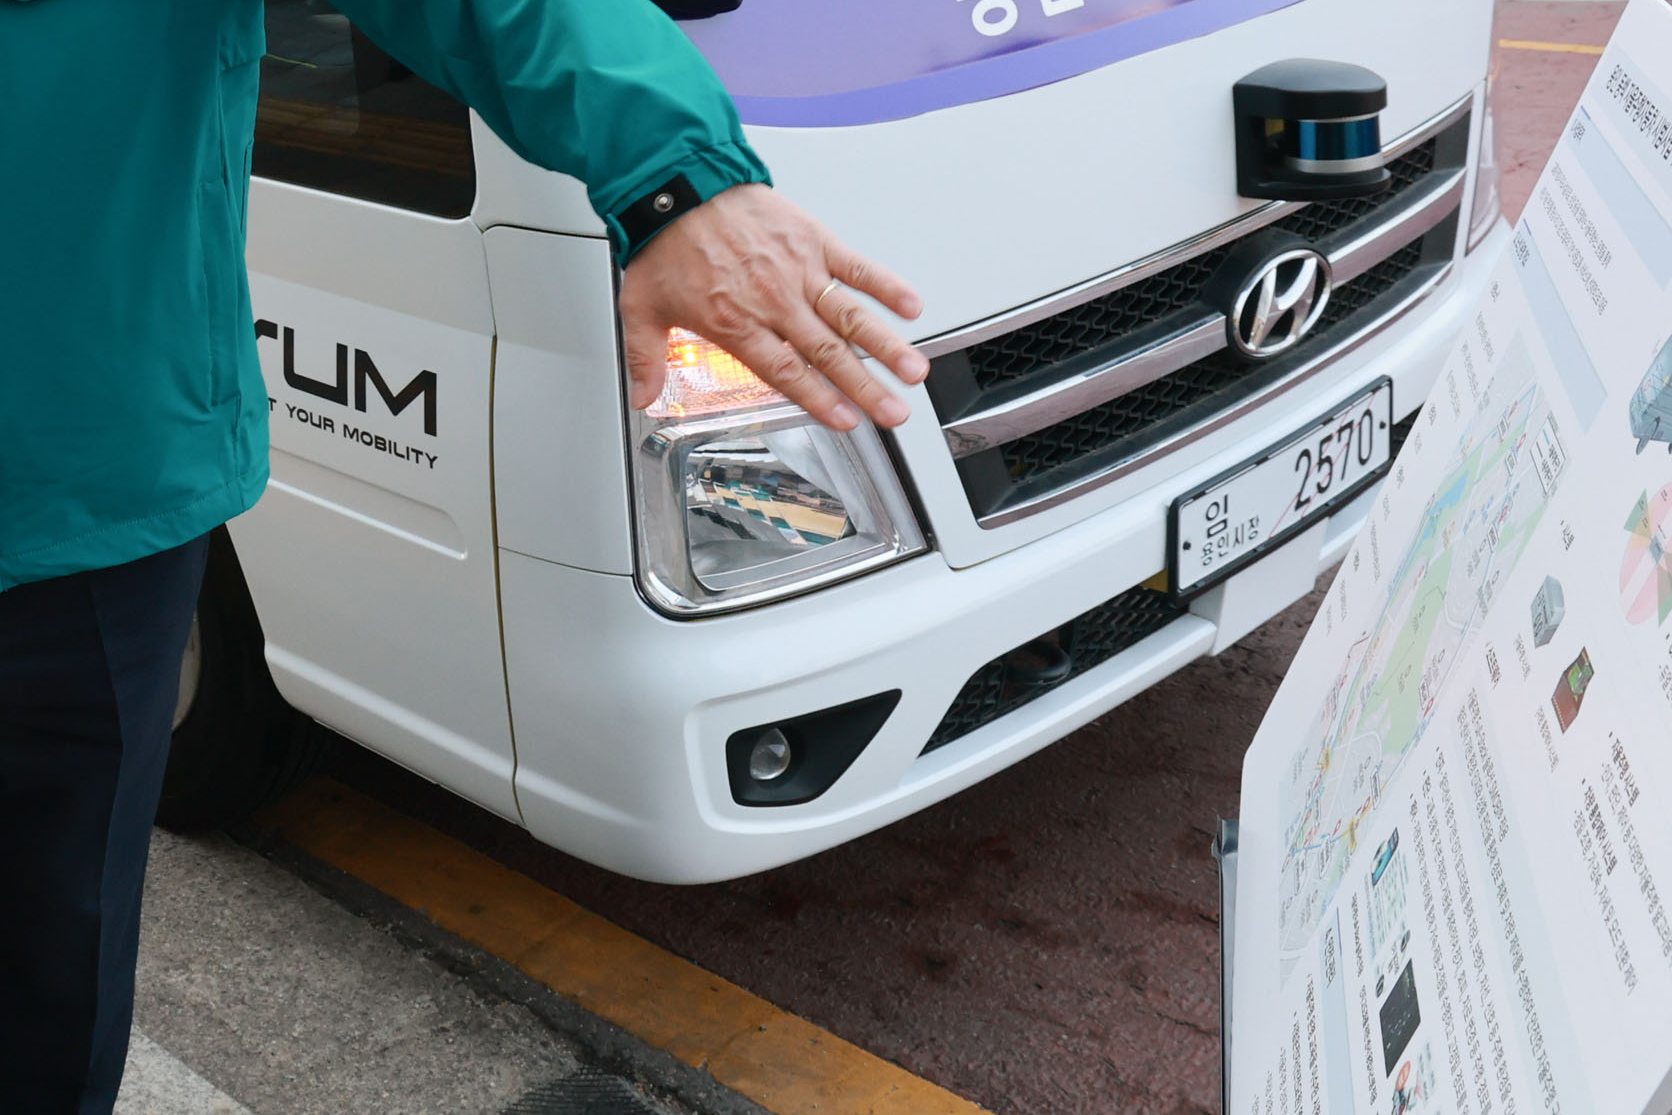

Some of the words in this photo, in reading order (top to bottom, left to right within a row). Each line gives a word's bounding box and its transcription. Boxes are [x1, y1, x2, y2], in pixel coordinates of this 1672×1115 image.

[285, 403, 335, 433] YOUR
[343, 423, 439, 470] MOBILITY
[1205, 494, 1229, 538] 임
[1294, 408, 1374, 512] 2570
[1201, 515, 1261, 567] 용인시장
[1583, 785, 1596, 812] 차량
[1611, 738, 1630, 780] 자율주행
[1623, 773, 1640, 807] 시스템
[1588, 803, 1608, 847] 통합제어
[1601, 840, 1618, 876] 시스템
